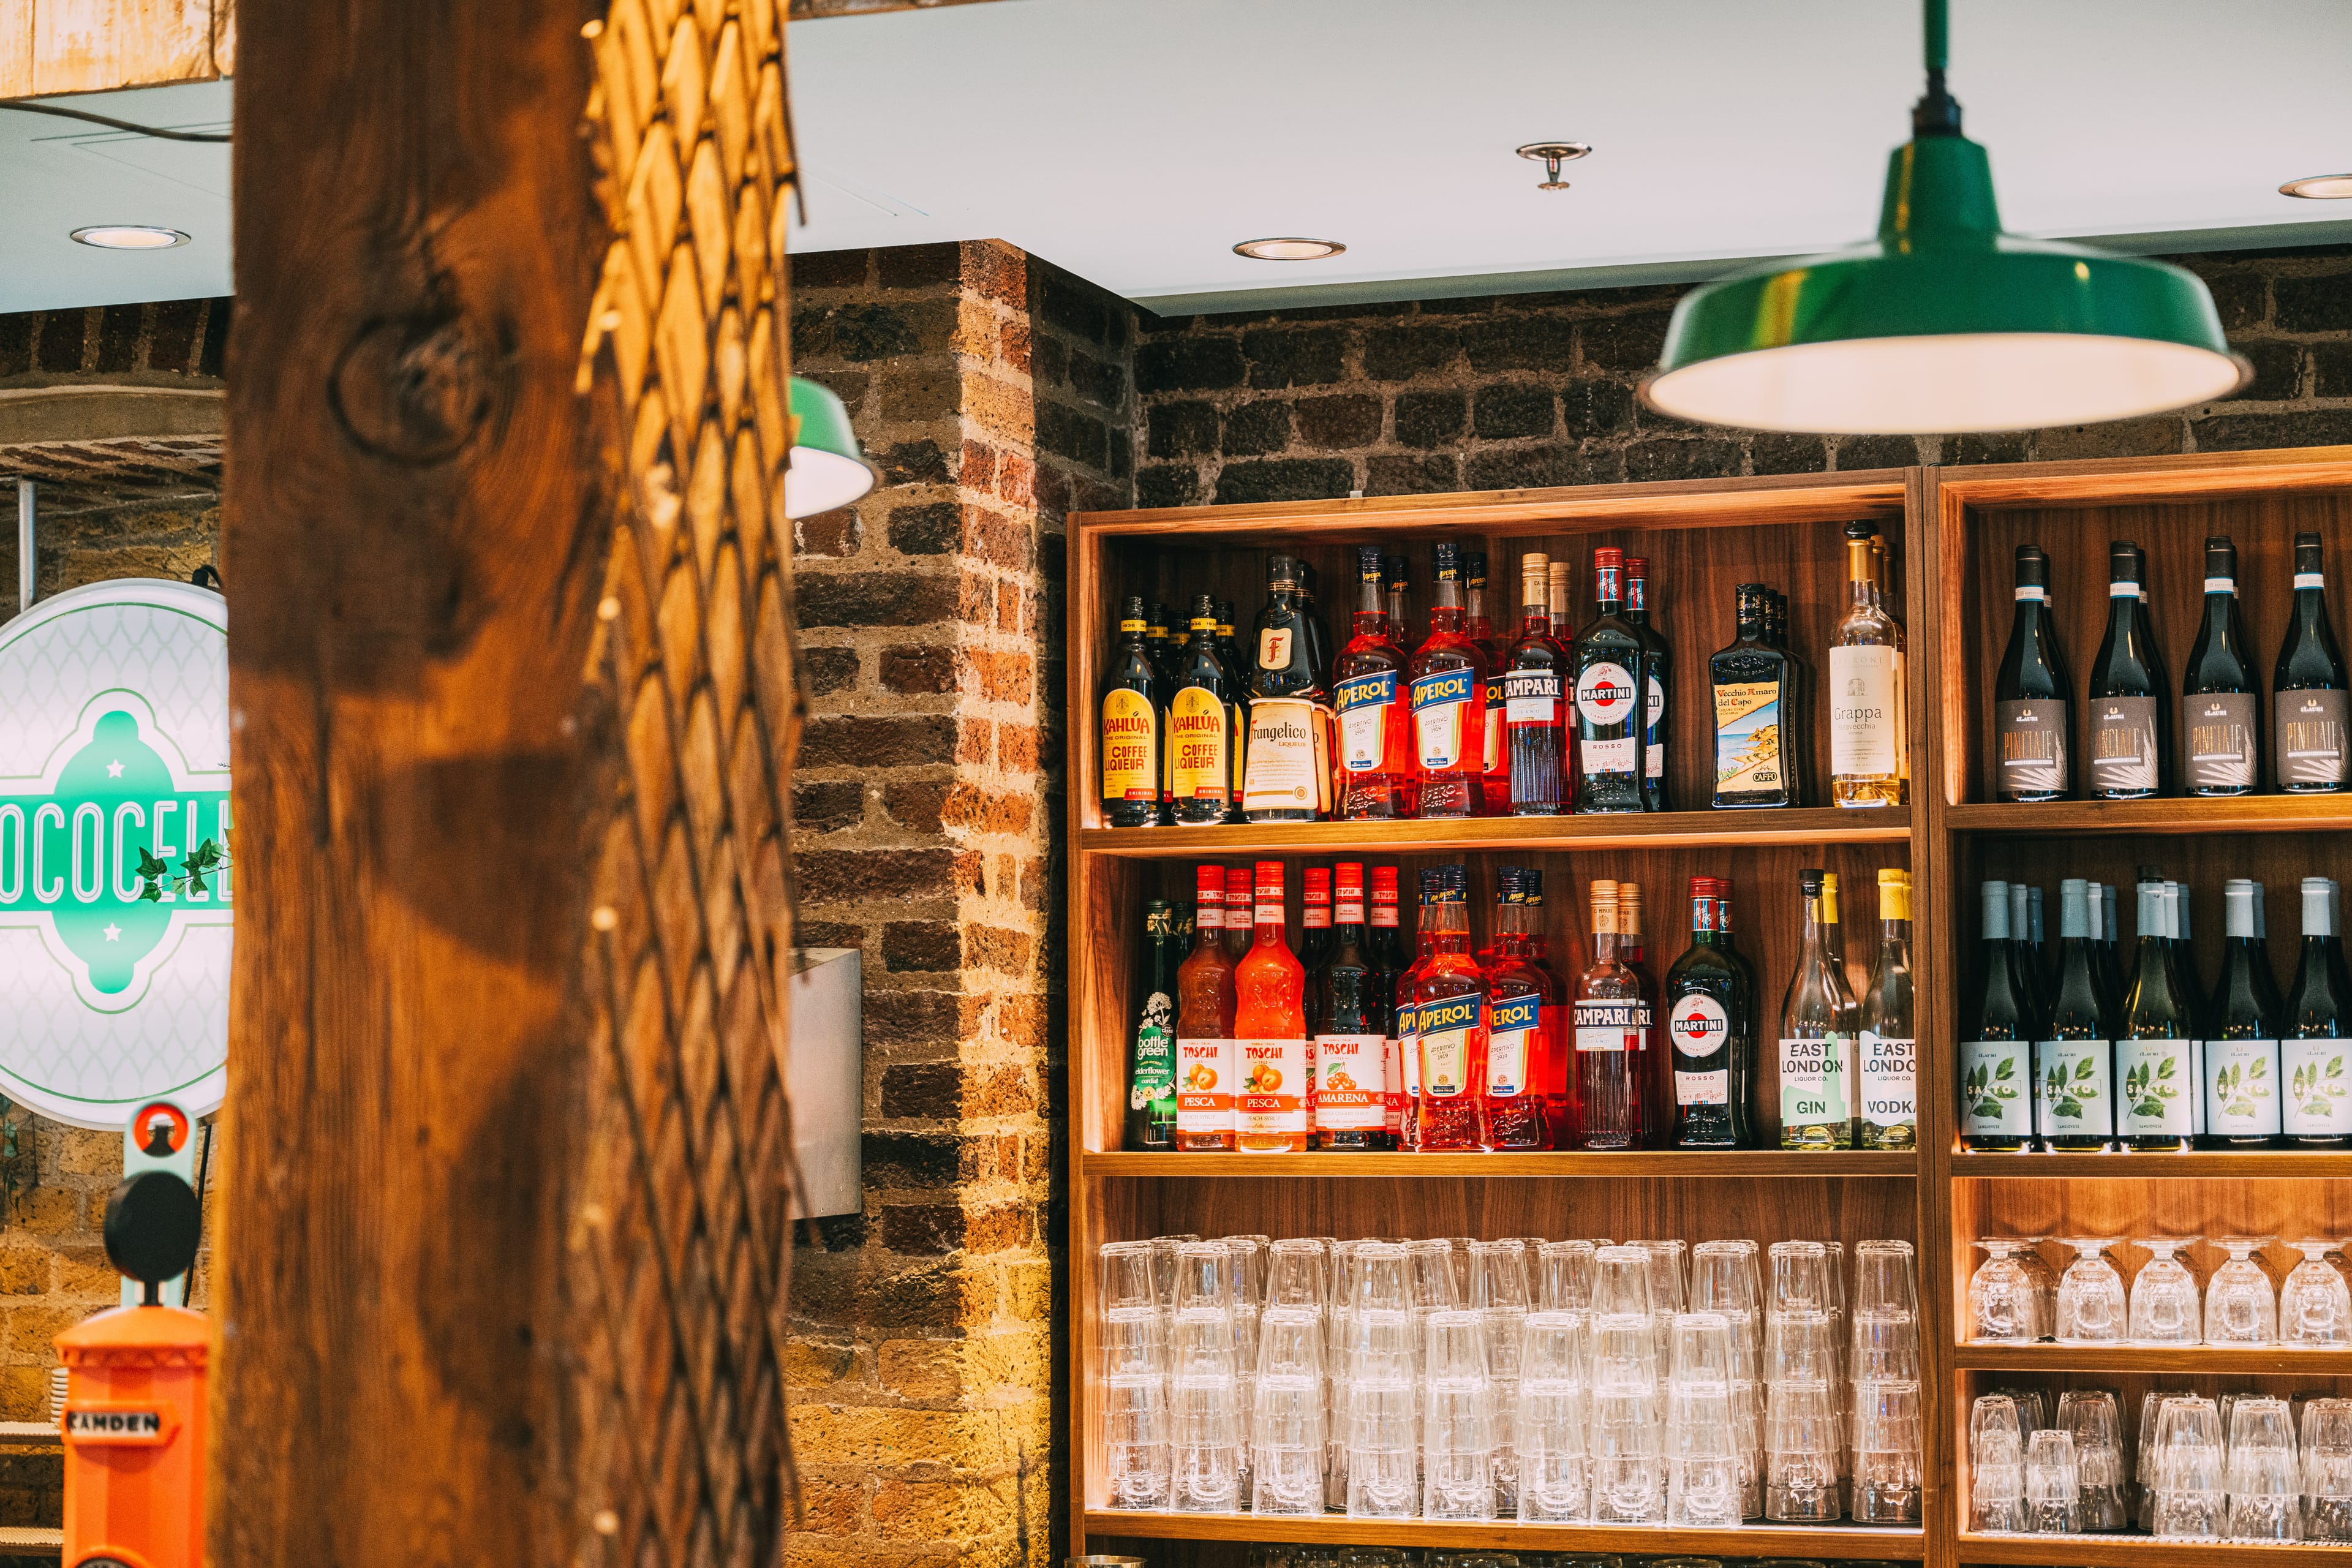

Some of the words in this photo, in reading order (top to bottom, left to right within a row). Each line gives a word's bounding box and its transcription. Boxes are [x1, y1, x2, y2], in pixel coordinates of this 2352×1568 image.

[1364, 571, 1382, 581] APEROL
[1336, 680, 1389, 711] APEROL
[1413, 678, 1466, 709] APEROL
[1582, 688, 1630, 701] MARTINI
[1731, 698, 1752, 707] Capo
[1425, 716, 1448, 726] APERITIVO
[1834, 707, 1882, 723] Grappa
[1349, 718, 1372, 729] APERITIVO
[1250, 719, 1306, 744] Frangelico
[1112, 746, 1147, 758] COFFEE
[1182, 744, 1218, 756] COFFEE
[1105, 758, 1144, 771] LIQUEUR
[1175, 757, 1215, 769] LIQUEUR
[1419, 1005, 1472, 1033] APEROL
[1493, 1005, 1532, 1027] EROL
[1676, 1020, 1722, 1031] MARTINI
[1139, 1035, 1168, 1047] bottle
[1137, 1047, 1168, 1060] green
[1183, 1047, 1218, 1058] TOSCHI
[1245, 1047, 1283, 1059] TOSCHI
[1323, 1043, 1359, 1055] TOSCHI
[1431, 1043, 1455, 1053] APERITIVO
[1491, 1044, 1515, 1053] APERITIVO
[1790, 1044, 1831, 1057] EAST
[1874, 1043, 1915, 1056] EAST
[1782, 1060, 1843, 1073] LONDON
[1864, 1060, 1915, 1072] LONDO
[1185, 1097, 1215, 1107] PESCA
[1247, 1099, 1281, 1108] PESCA
[1317, 1093, 1368, 1102] AMARENA
[1796, 1101, 1826, 1114] GIN
